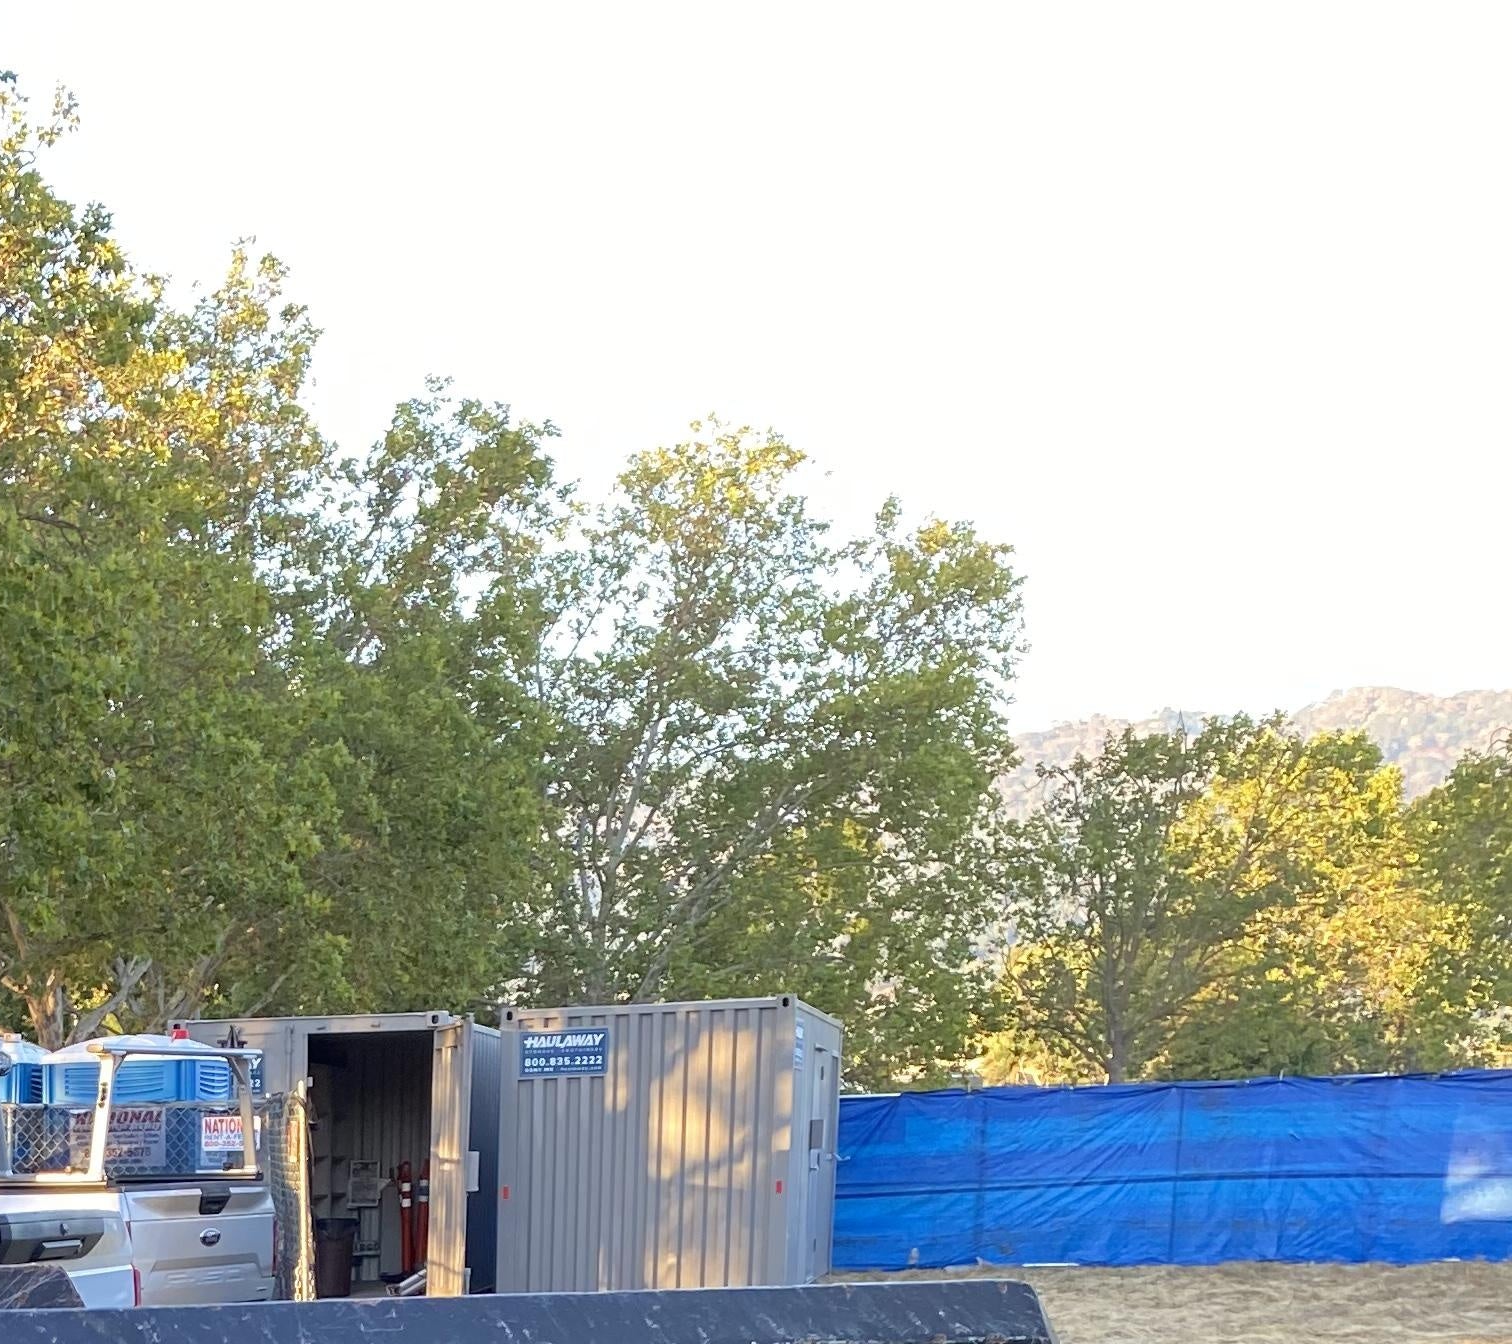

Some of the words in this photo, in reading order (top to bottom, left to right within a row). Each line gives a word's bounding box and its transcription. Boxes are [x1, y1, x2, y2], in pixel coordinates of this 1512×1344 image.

[523, 1033, 605, 1048] HAULAWAY
[75, 1110, 163, 1125] NAIONAL
[204, 1118, 243, 1135] NATION
